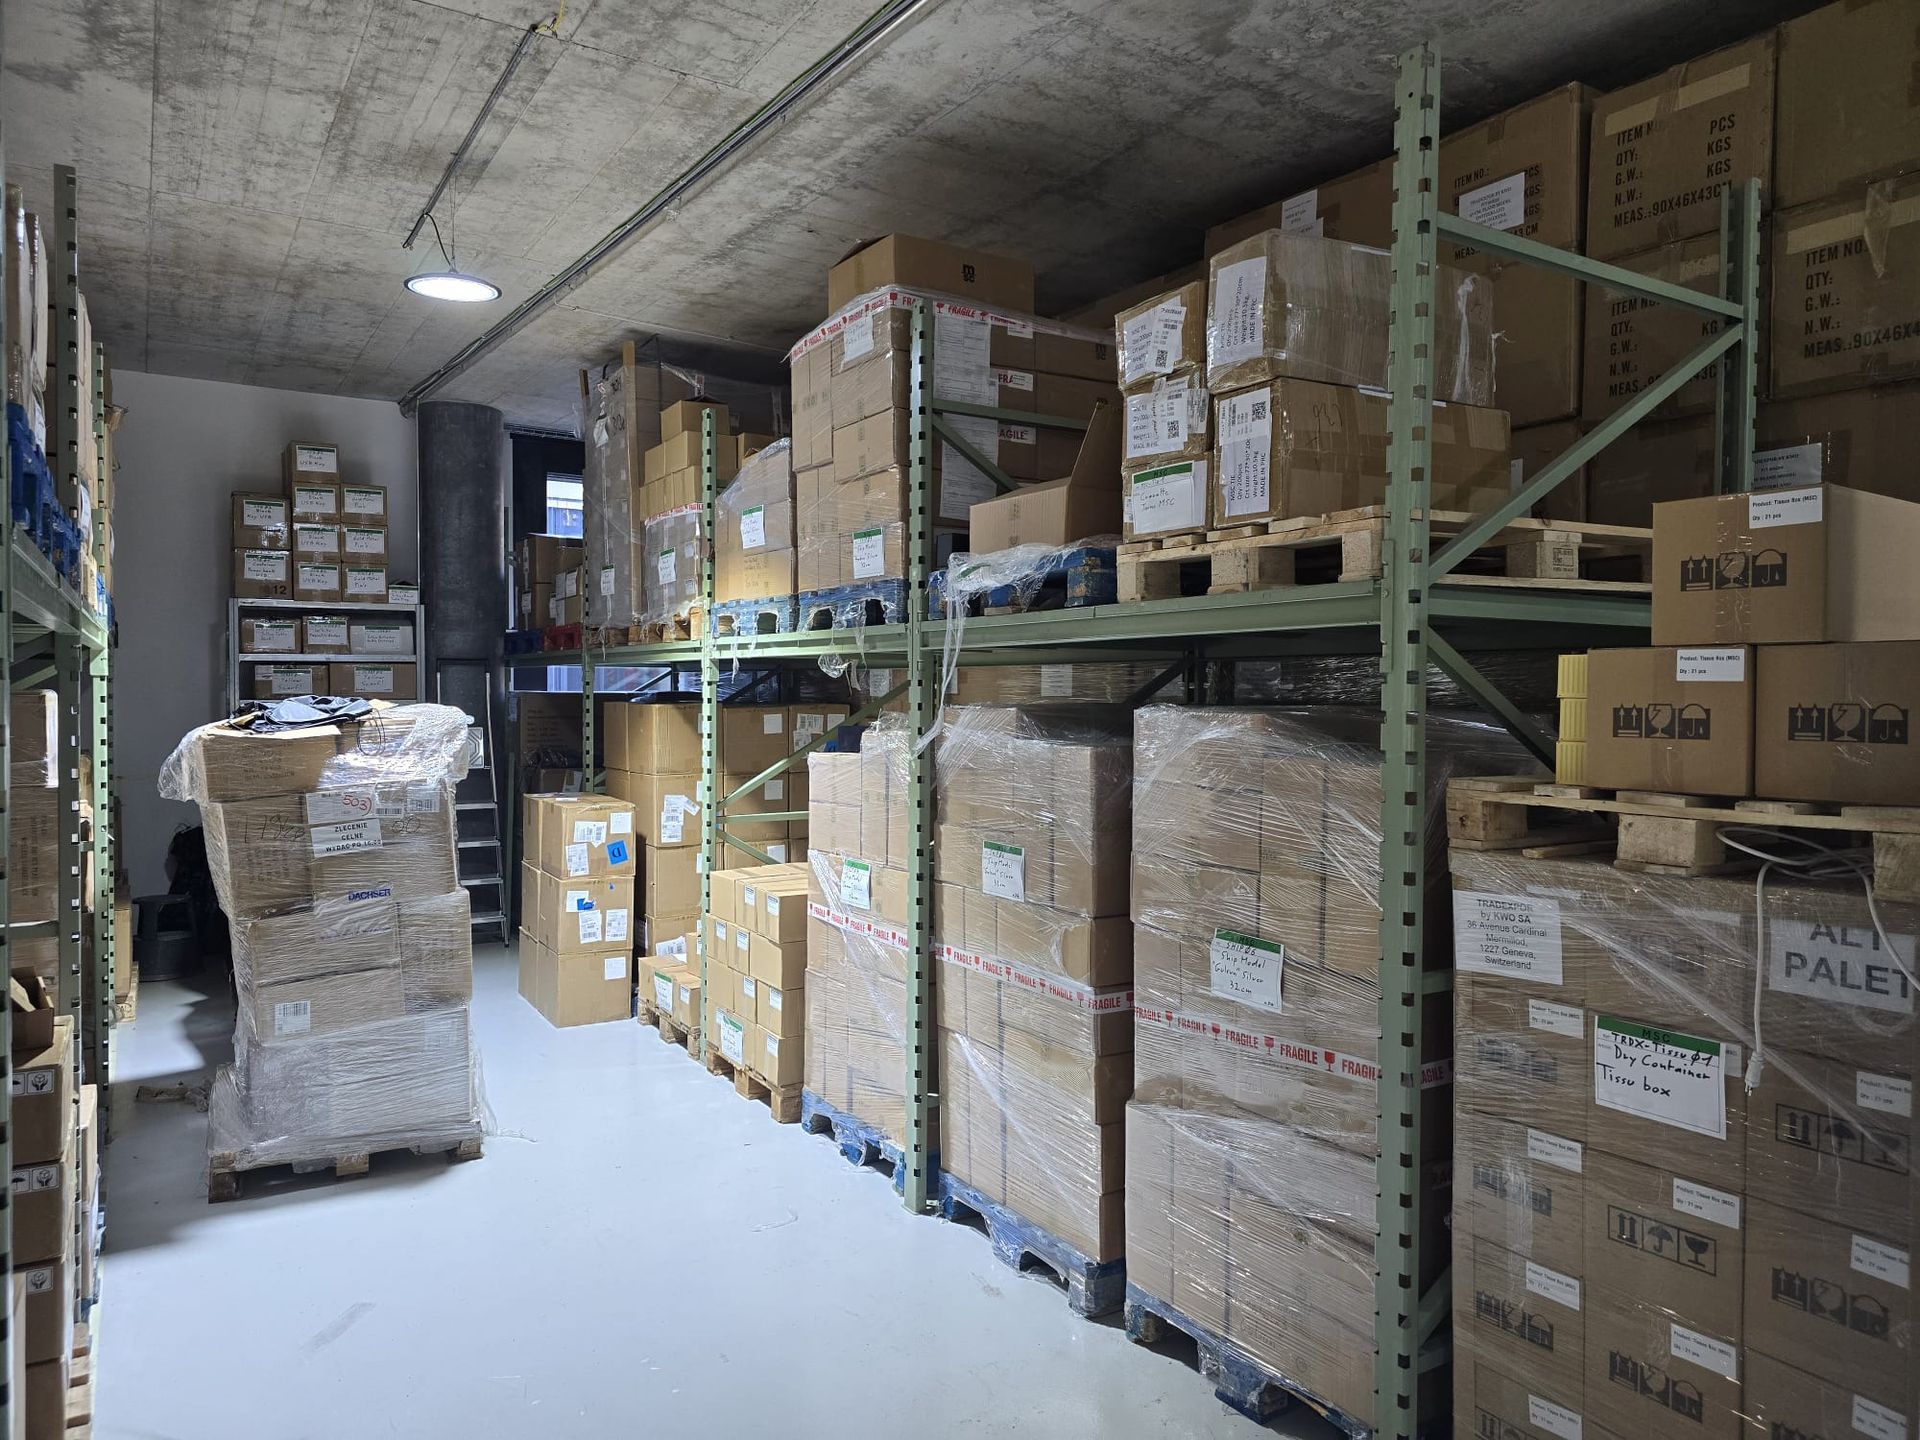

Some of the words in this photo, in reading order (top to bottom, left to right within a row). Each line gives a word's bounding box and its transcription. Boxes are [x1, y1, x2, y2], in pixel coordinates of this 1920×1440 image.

[1710, 113, 1735, 135] PCS
[1617, 128, 1642, 147] ITEM
[1706, 136, 1731, 157] KGS
[1616, 148, 1638, 167] QTY:
[1615, 168, 1643, 186] G.W.:
[1706, 158, 1731, 179] KGS
[1454, 174, 1473, 189] ITEM
[1614, 189, 1643, 207] N.W.:
[1806, 246, 1838, 268] ITEM
[1805, 271, 1833, 290] QTY:
[948, 304, 976, 318] FRAGILE
[1612, 298, 1637, 317] ITEM
[1805, 292, 1840, 312] G.W.:
[1611, 320, 1634, 337] QTY:
[1804, 316, 1840, 335] N.W.:
[1610, 339, 1637, 356] G.W.:
[1609, 361, 1638, 377] N.W.:
[998, 428, 1026, 440] AGILE
[335, 822, 368, 833] ZLECENIE
[341, 832, 364, 841] CELNE
[348, 888, 391, 901] DACHSER
[1481, 911, 1491, 920] by
[1493, 912, 1516, 922] KWO
[1517, 915, 1531, 924] SA
[850, 919, 865, 933] FRAGILE
[873, 928, 890, 941] FRAGILE
[1467, 920, 1477, 928] 36
[1479, 921, 1510, 933] Avenue
[1512, 925, 1547, 937] Cardinal
[1221, 951, 1237, 966] Ship
[1241, 956, 1266, 969] Model
[1481, 944, 1499, 954] 1227
[1501, 946, 1536, 960] Geneva,
[1485, 955, 1531, 970] Switzerland
[953, 950, 973, 966] FRAGILE
[982, 960, 1003, 977] FRAGILE
[1014, 972, 1037, 988] FRAGILE
[1049, 984, 1073, 1001] FRAGILE
[1088, 996, 1121, 1011] FRAGILE
[1135, 1006, 1162, 1023] FRAGILE
[1225, 1028, 1259, 1049] FRAGILE
[1280, 1043, 1318, 1065] FRAGILE
[1642, 1028, 1671, 1043] MSC
[1614, 1044, 1637, 1067] Dry
[1641, 1054, 1711, 1080] Container
[1596, 1062, 1635, 1087] Tissu
[1643, 1075, 1671, 1098] box
